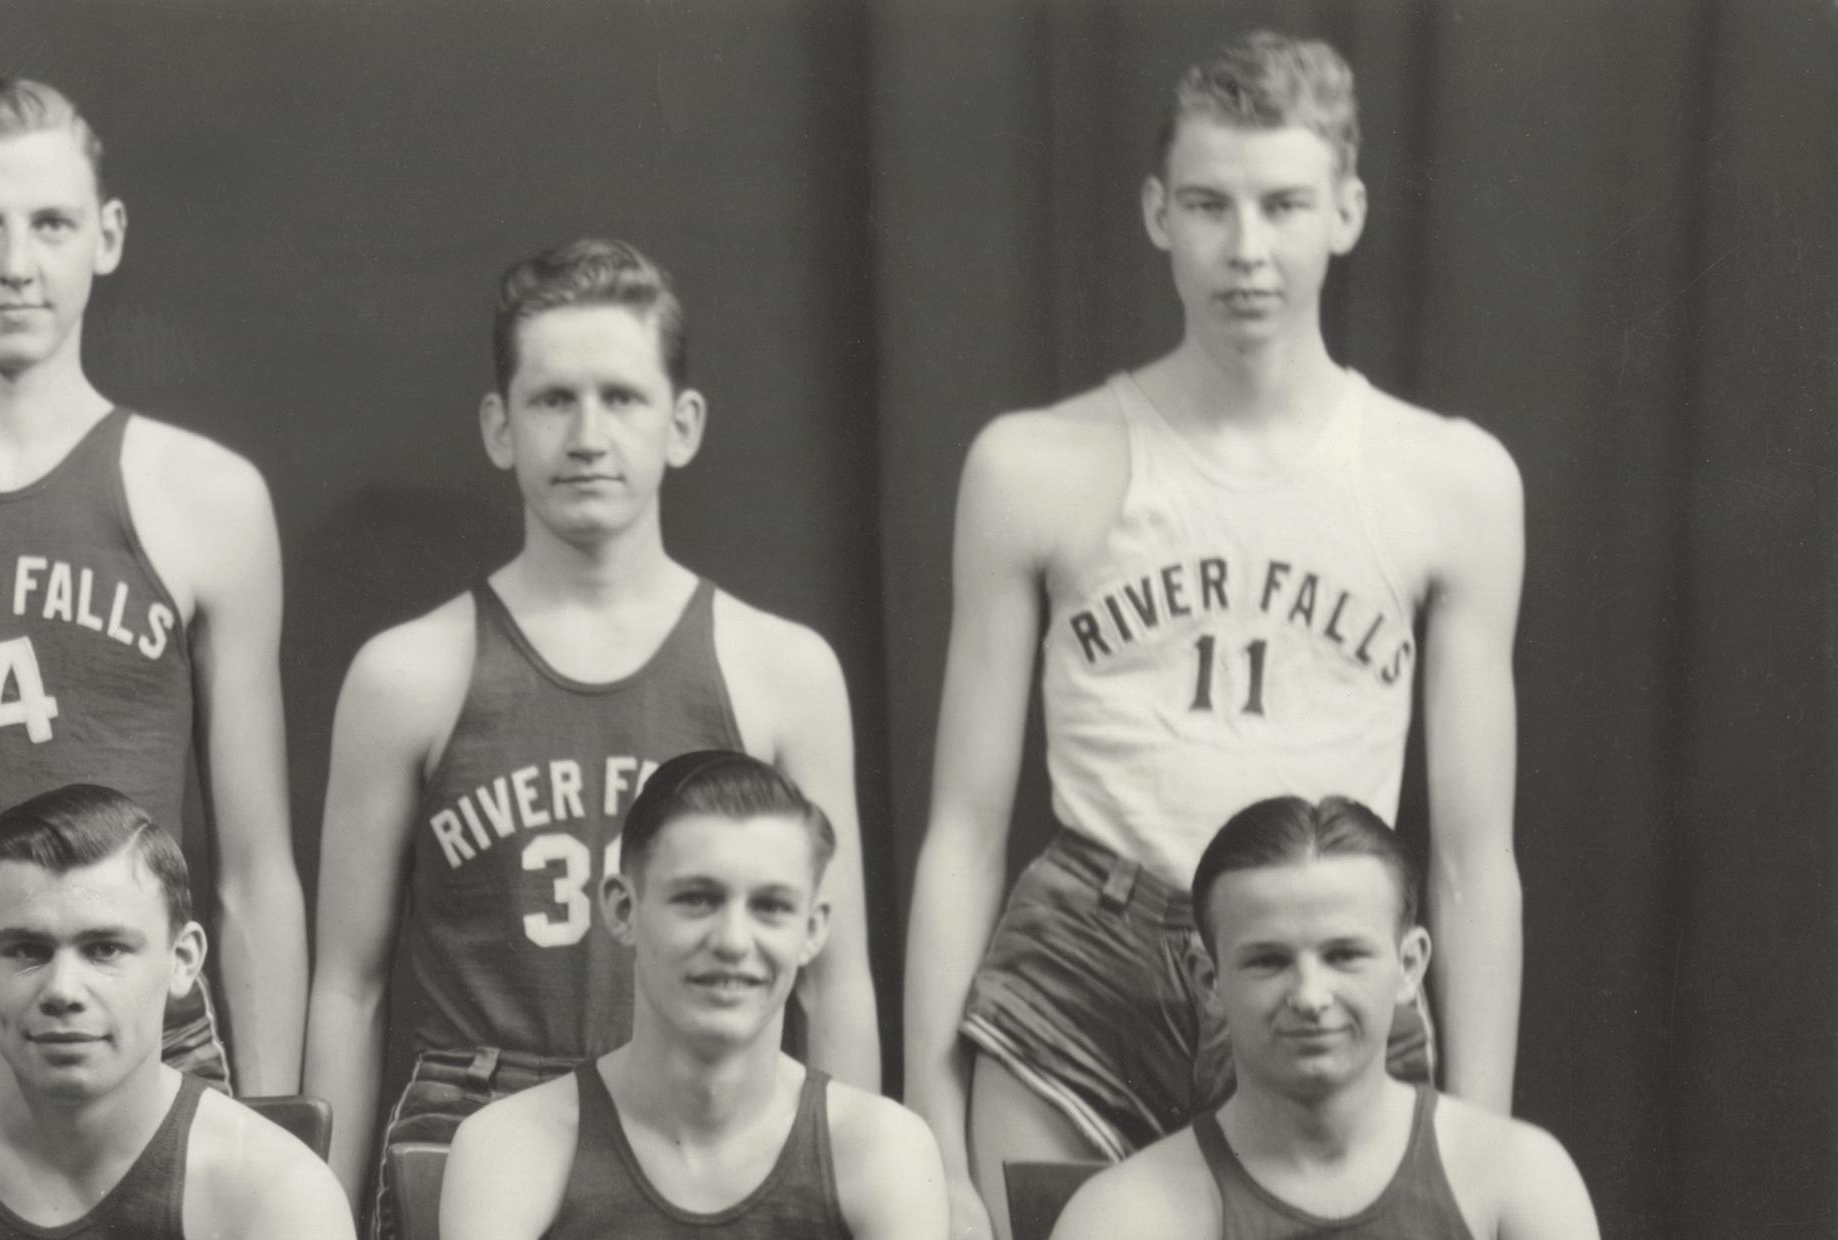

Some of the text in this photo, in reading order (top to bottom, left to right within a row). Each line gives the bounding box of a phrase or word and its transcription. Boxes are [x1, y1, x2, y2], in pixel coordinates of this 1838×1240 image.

[12, 555, 175, 660] FALLS
[1070, 557, 1412, 684] RIVER FALLS
[1188, 634, 1267, 716] 11
[430, 758, 586, 869] RIVER
